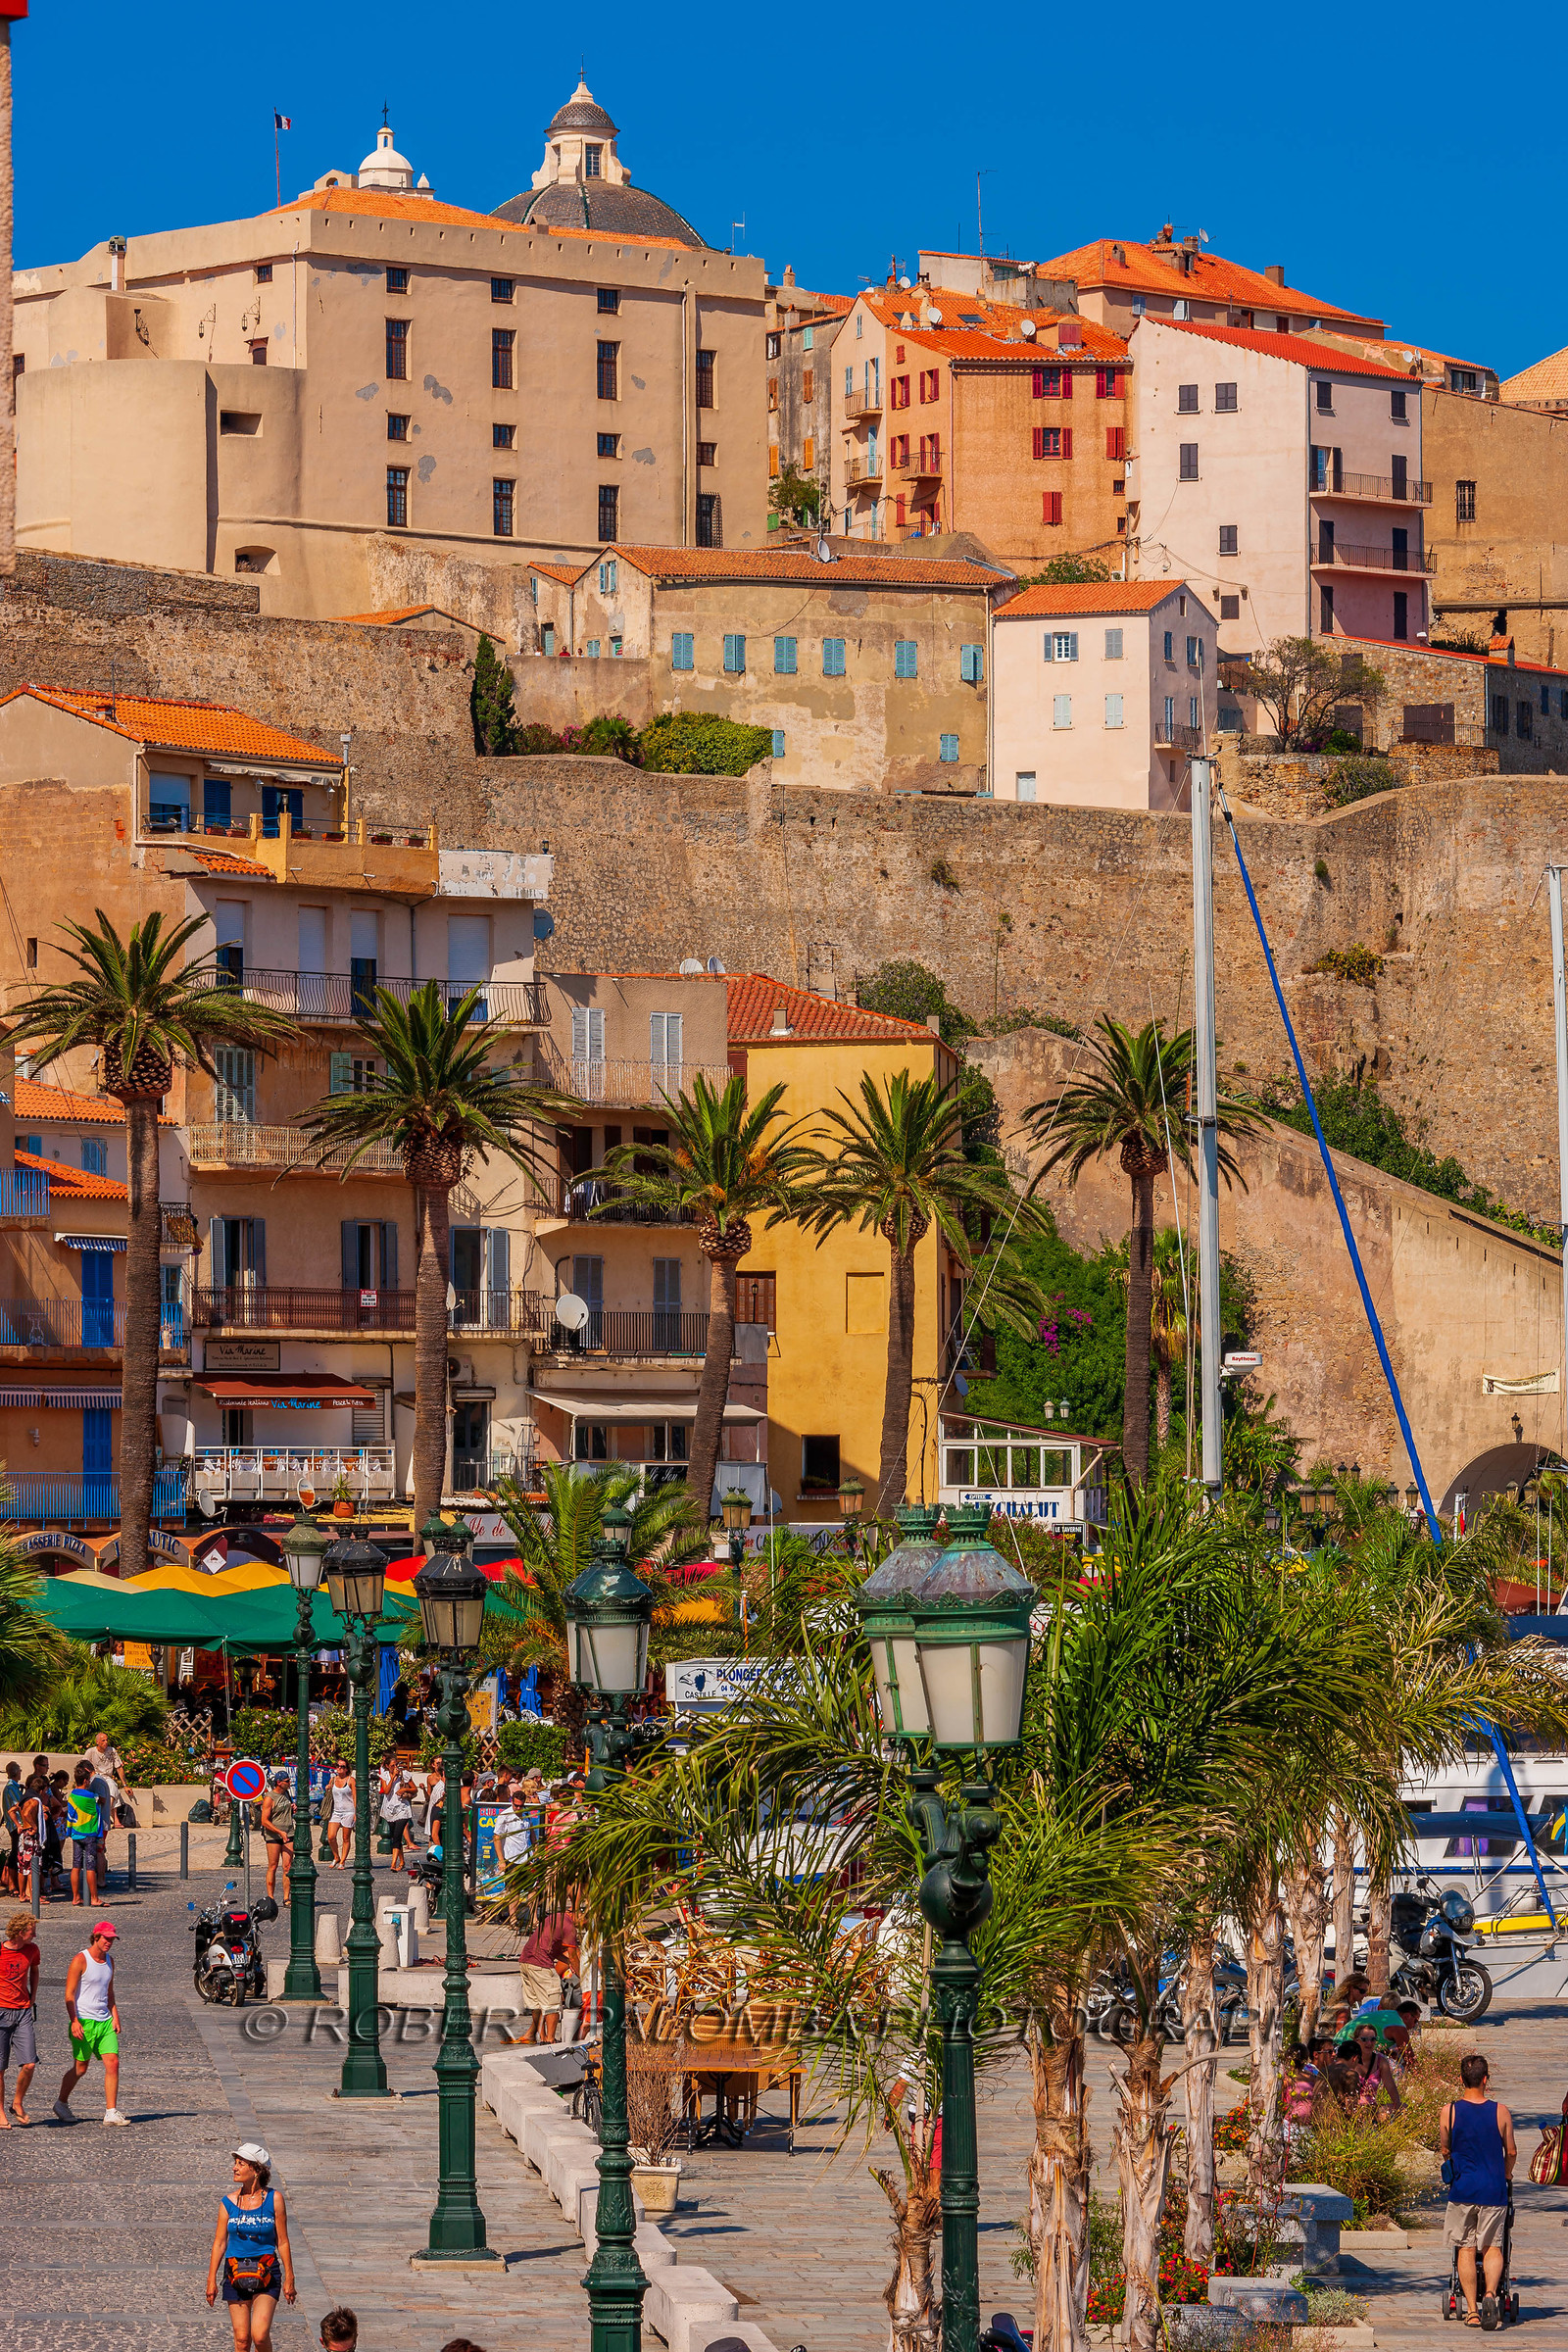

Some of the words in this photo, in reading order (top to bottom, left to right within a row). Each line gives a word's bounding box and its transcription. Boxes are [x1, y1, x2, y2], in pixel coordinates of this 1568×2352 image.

[220, 1345, 234, 1355] Via
[235, 1344, 267, 1355] Marine
[270, 1397, 288, 1409] Via
[288, 1397, 321, 1409] Marine
[995, 1501, 1059, 1518] CHALUT
[63, 1535, 86, 1558] PIZZA
[684, 1690, 716, 1699] CASTILLE
[479, 1807, 497, 1817] CLUB
